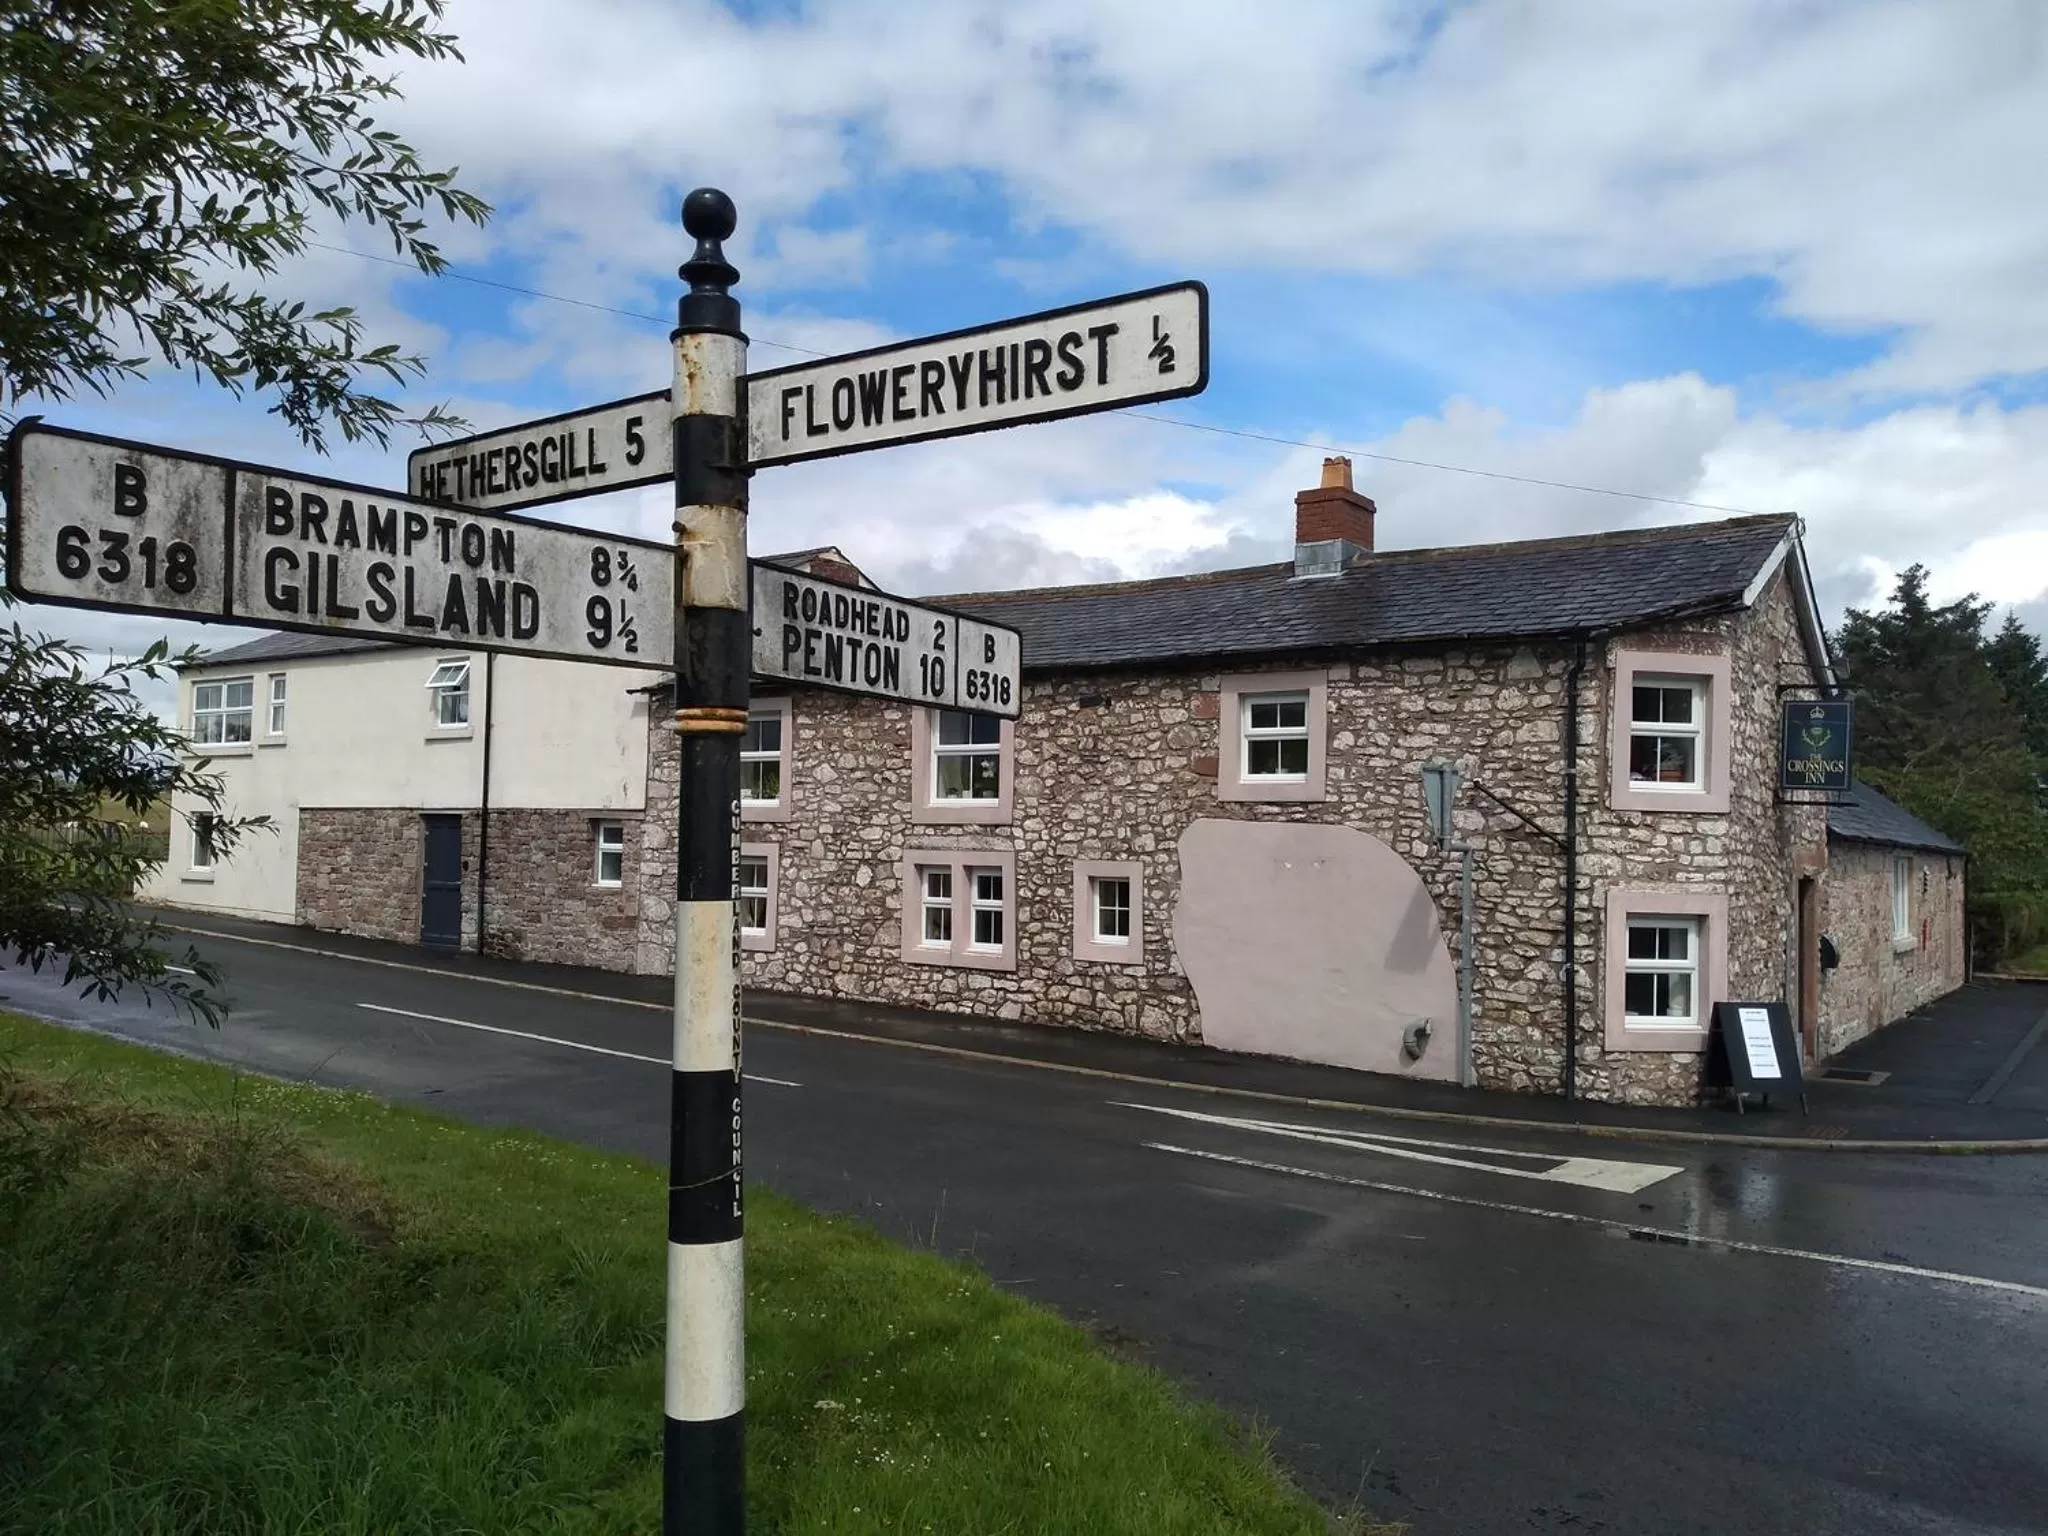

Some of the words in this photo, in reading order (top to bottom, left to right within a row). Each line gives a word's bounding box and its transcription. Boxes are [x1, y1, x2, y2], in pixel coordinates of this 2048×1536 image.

[780, 322, 1120, 441] FLOWERYHIRST
[114, 463, 148, 517] B
[420, 427, 607, 501] HETHERSGILL
[625, 416, 646, 466] 5
[56, 525, 198, 594] 6318
[265, 485, 516, 573] BRAMPTON
[264, 546, 540, 641] GILSLAND
[783, 581, 910, 642] ROADHEAD
[933, 619, 946, 651] 2
[782, 623, 900, 691] PENTON
[919, 653, 946, 698] 10
[984, 633, 996, 664] B
[966, 668, 1012, 706] 6318
[1787, 759, 1845, 773] CROSSINGS
[1804, 771, 1826, 784] INN
[730, 800, 742, 969] CUMBERLAND
[732, 982, 742, 1084] COUNTY
[732, 1098, 742, 1218] COUNCIL
